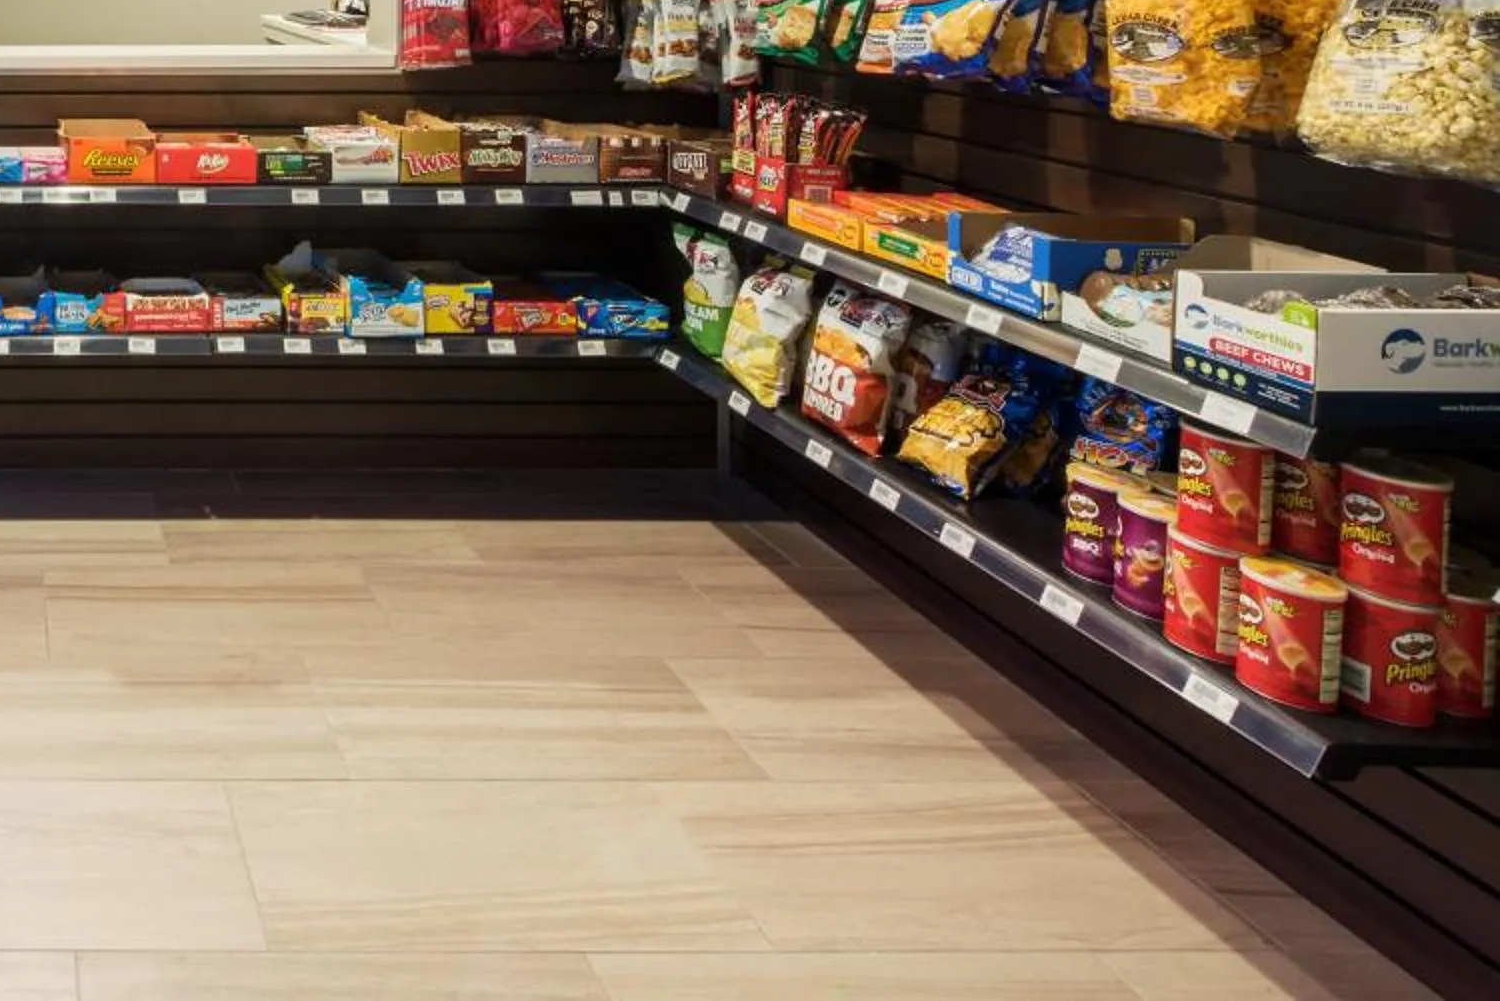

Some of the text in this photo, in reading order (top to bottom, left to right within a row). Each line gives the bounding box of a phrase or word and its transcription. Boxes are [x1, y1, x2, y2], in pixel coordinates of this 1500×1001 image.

[1214, 339, 1305, 376] BEEF CHEWS
[1072, 538, 1100, 553] BBQ
[1350, 542, 1396, 564] Original
[1386, 661, 1436, 686] Pringl
